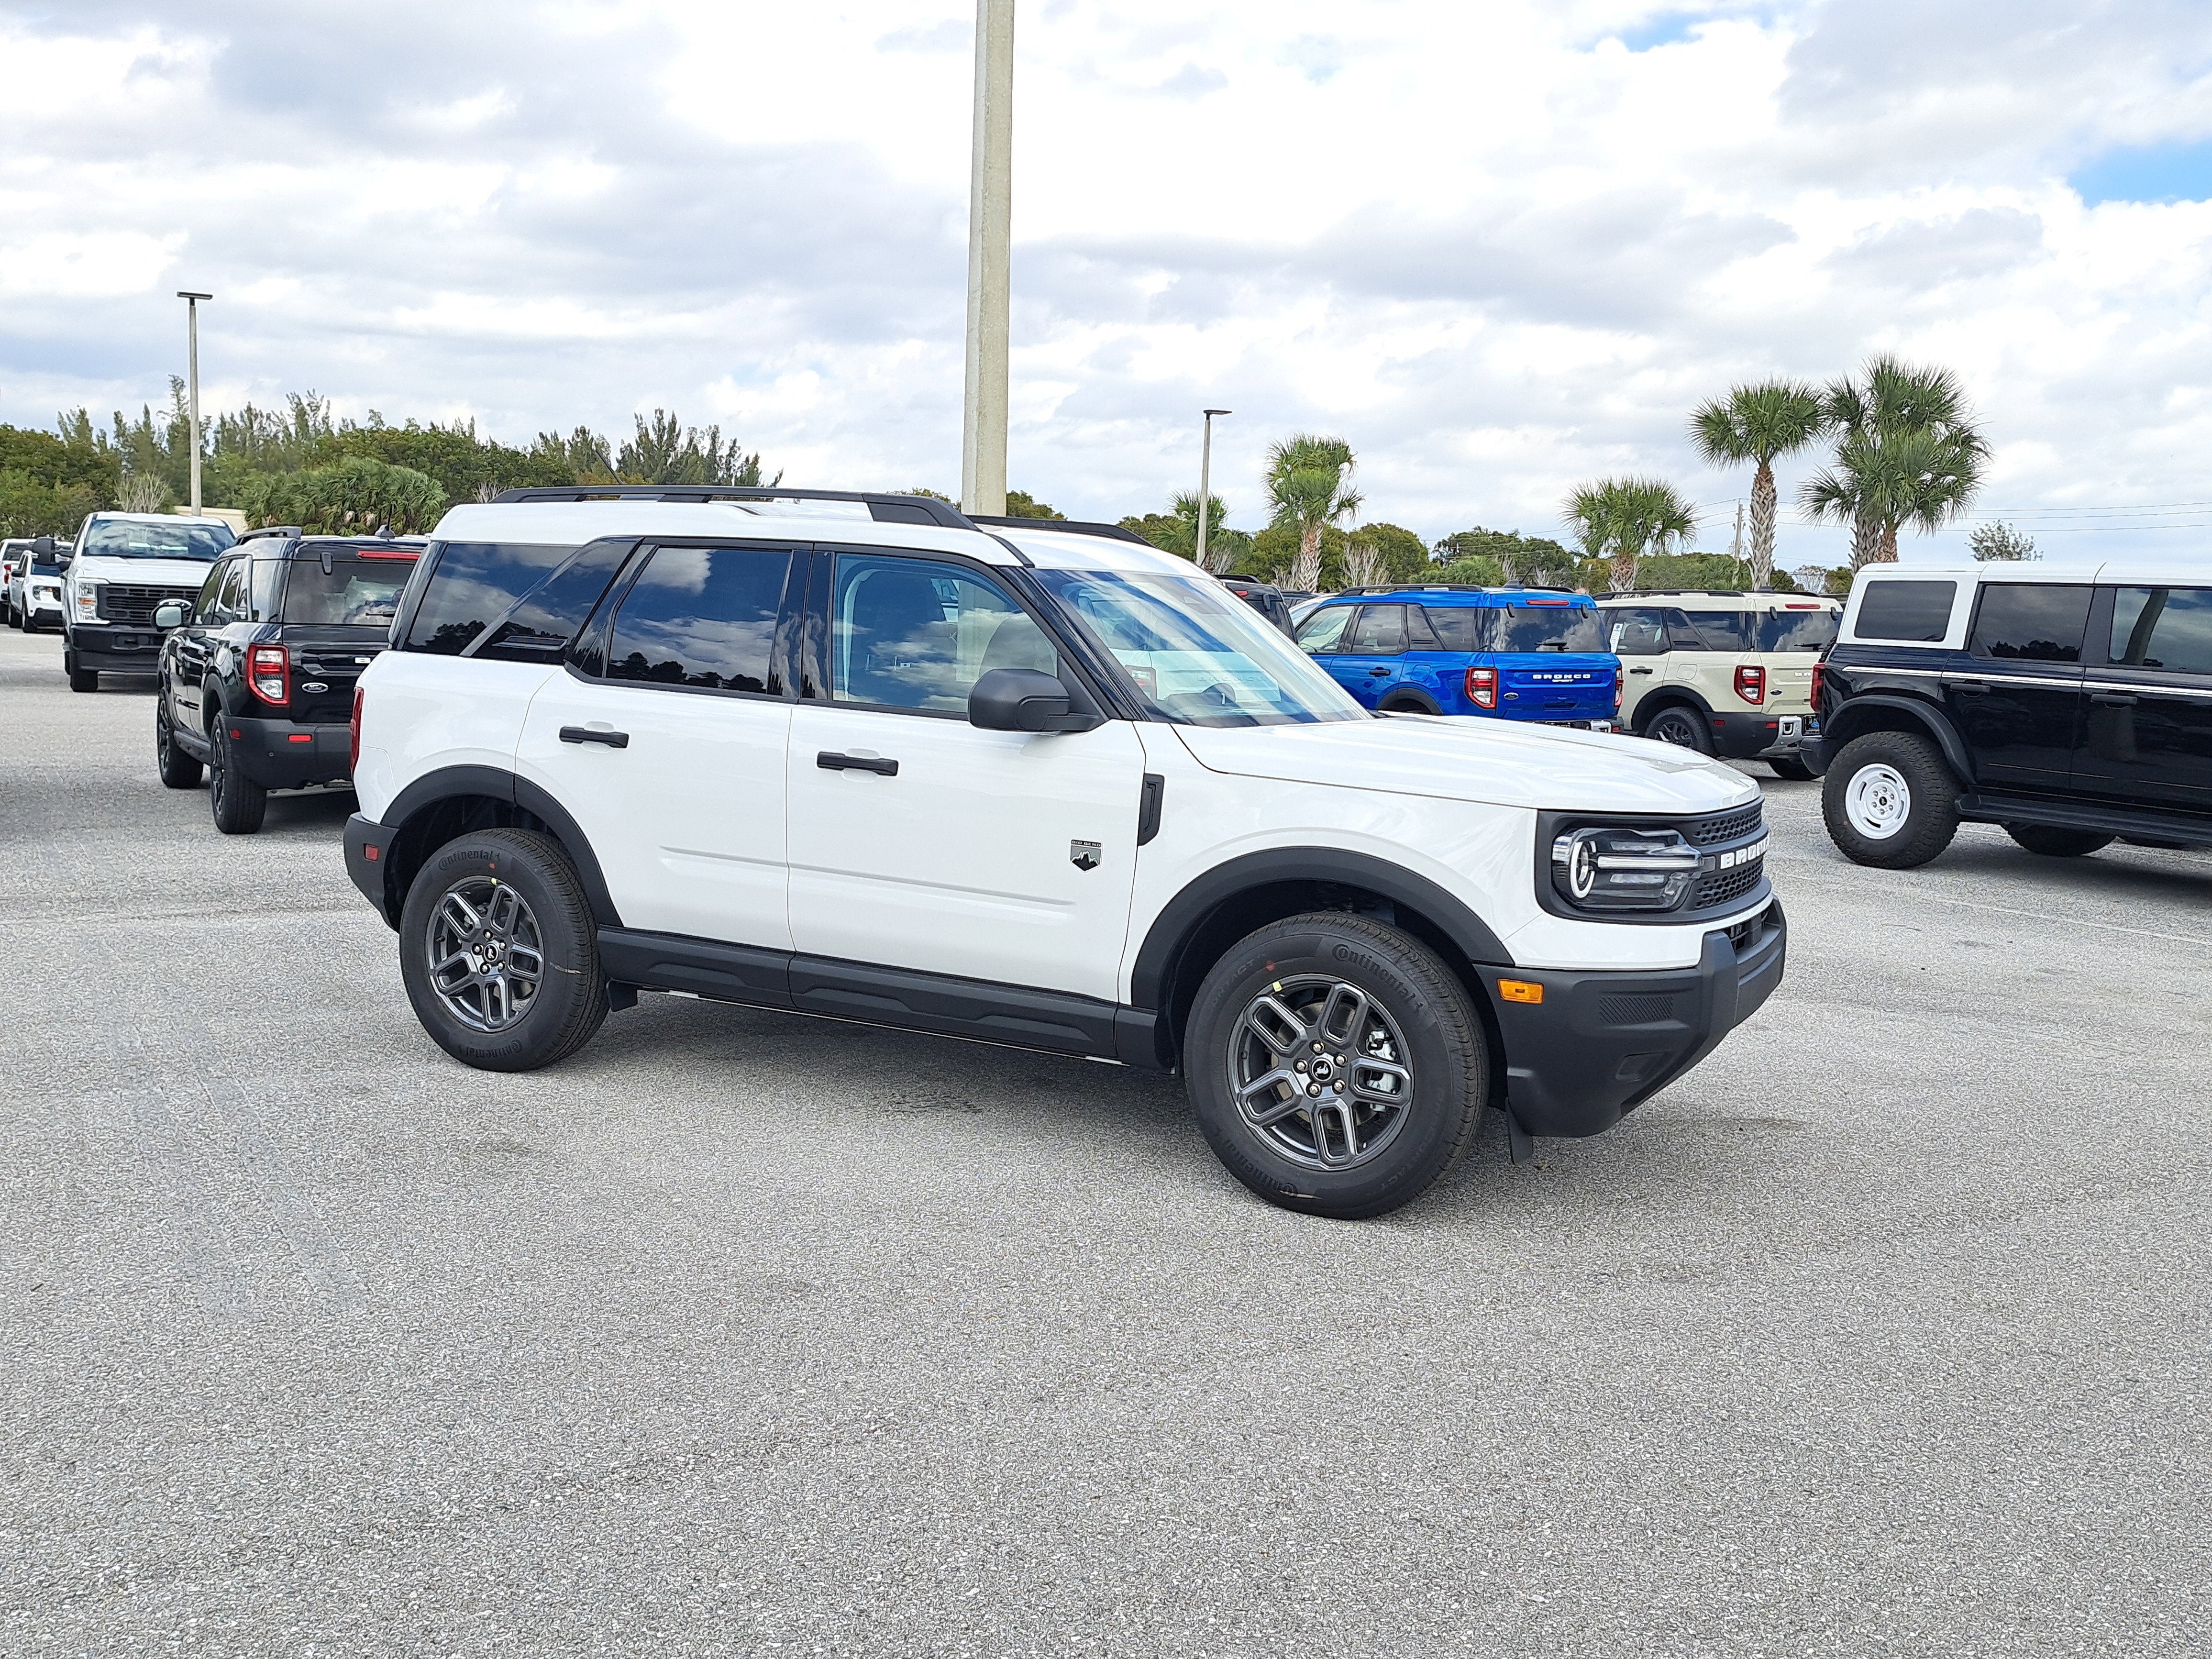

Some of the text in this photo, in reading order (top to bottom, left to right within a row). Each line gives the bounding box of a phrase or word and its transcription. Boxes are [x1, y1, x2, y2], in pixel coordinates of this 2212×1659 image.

[438, 850, 493, 871] Continental
[1720, 833, 1770, 869] BRON
[1332, 944, 1416, 1003] Continental
